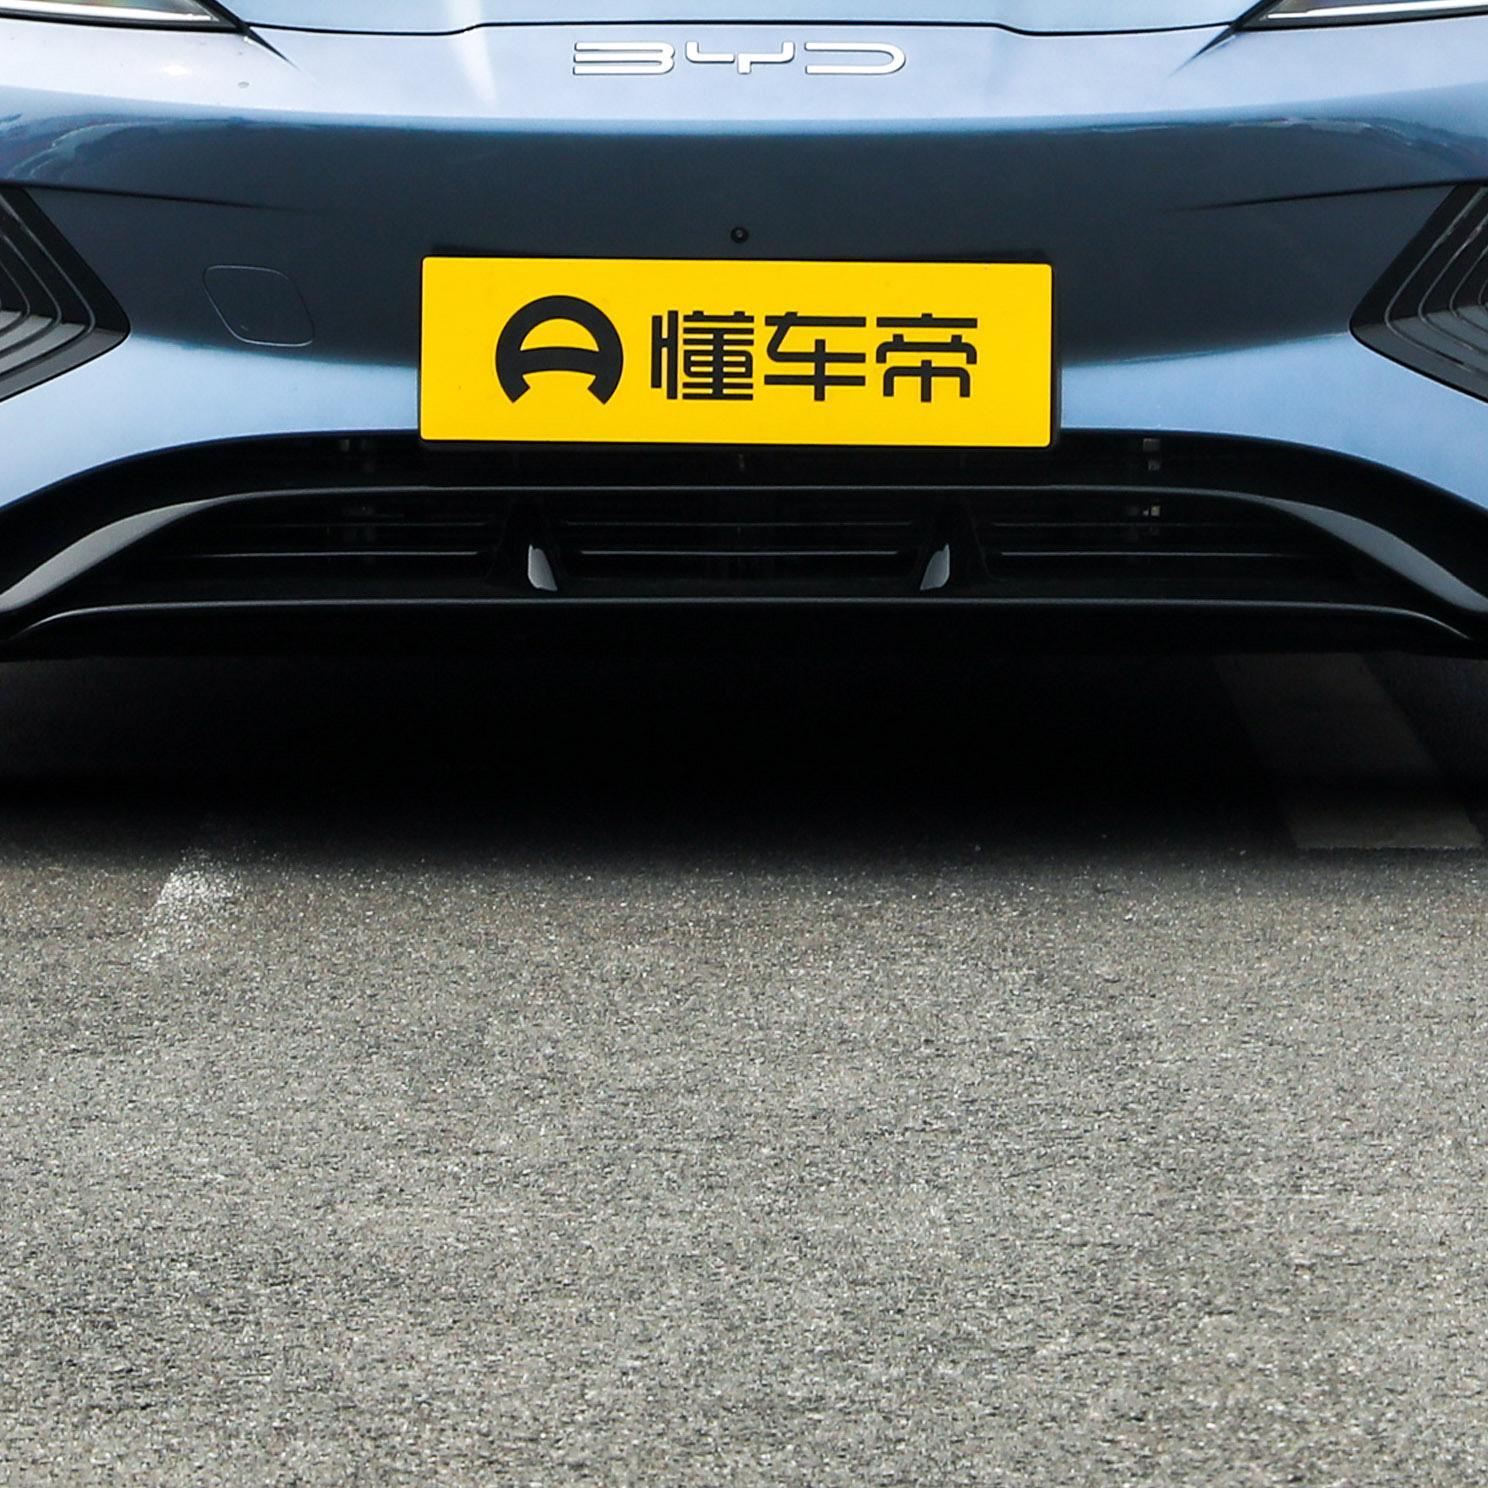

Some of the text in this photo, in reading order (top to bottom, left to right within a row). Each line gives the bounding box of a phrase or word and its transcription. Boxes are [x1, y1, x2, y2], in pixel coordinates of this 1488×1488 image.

[573, 41, 906, 75] BYD
[650, 309, 978, 403] 懂车帝
